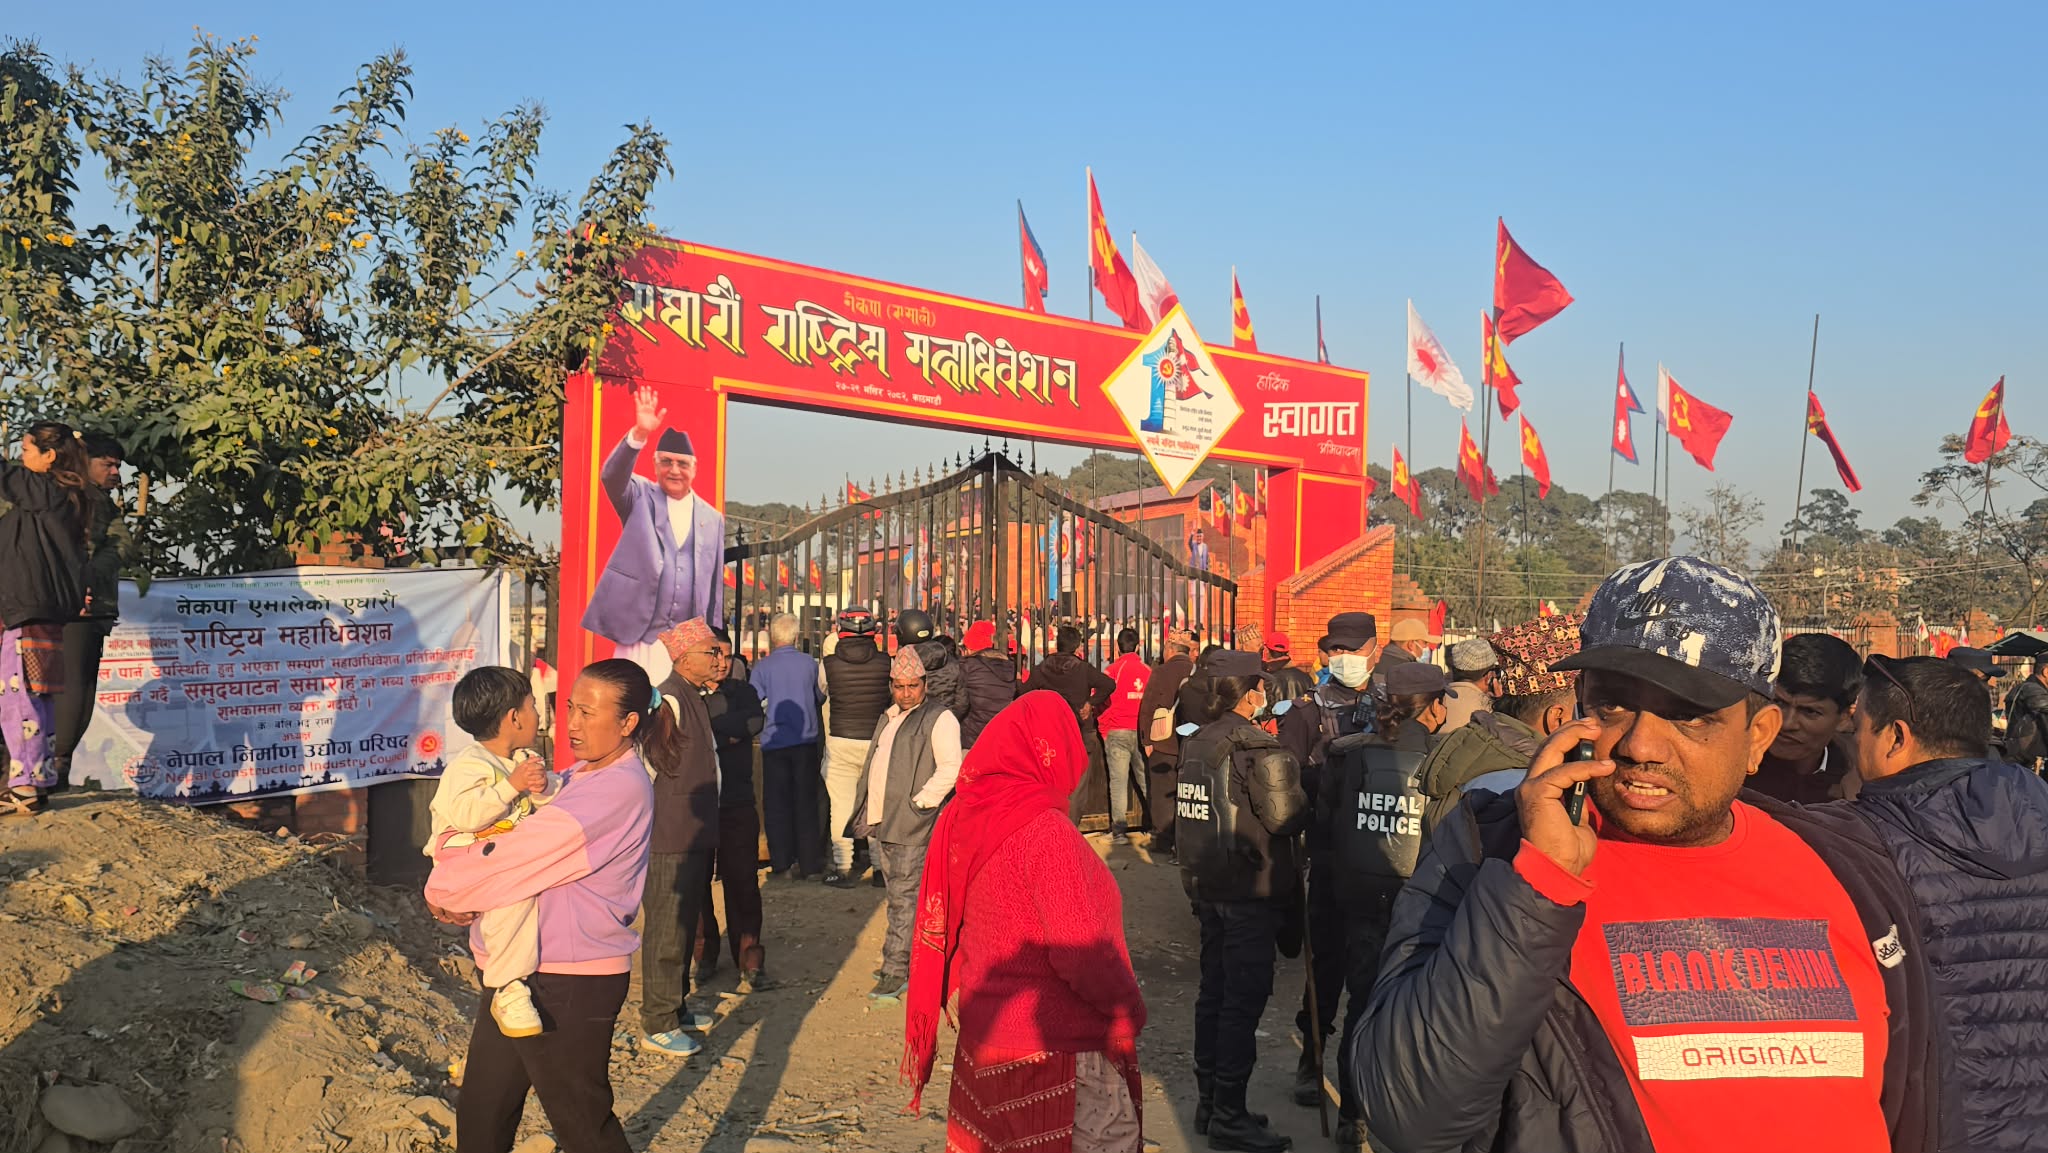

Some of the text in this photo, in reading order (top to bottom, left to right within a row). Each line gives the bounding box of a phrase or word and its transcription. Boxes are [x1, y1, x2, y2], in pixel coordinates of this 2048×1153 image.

[902, 331, 1080, 408] महाधिवेशन
[1256, 371, 1290, 391] हार्दिक
[1263, 401, 1359, 438] स्वागत
[176, 595, 237, 616] नेकपा
[249, 595, 330, 618] एमालेको
[181, 618, 394, 656] राष्ट्रिय महाधिवेशन
[151, 661, 211, 678] उपस्थिति
[242, 660, 281, 675] भएका
[98, 689, 142, 705] स्वागत
[290, 673, 356, 696] समारोह
[361, 676, 377, 688] को
[217, 702, 282, 721] शुभकामना
[166, 750, 223, 768] नेपाल
[232, 743, 298, 764] निर्माण
[360, 734, 410, 753] परिषद
[165, 768, 207, 784] Nepal
[212, 763, 305, 780] Construction
[310, 757, 366, 772] Industry
[369, 752, 408, 765] Council
[1177, 782, 1209, 801] NEPAL
[1177, 801, 1209, 821] POLICE
[1358, 792, 1421, 816] NEPAL
[1356, 812, 1420, 836] POLICE
[1619, 948, 1743, 994] BLANK
[1746, 947, 1841, 990] DENIM
[1682, 1045, 1828, 1067] ORIGINAL
